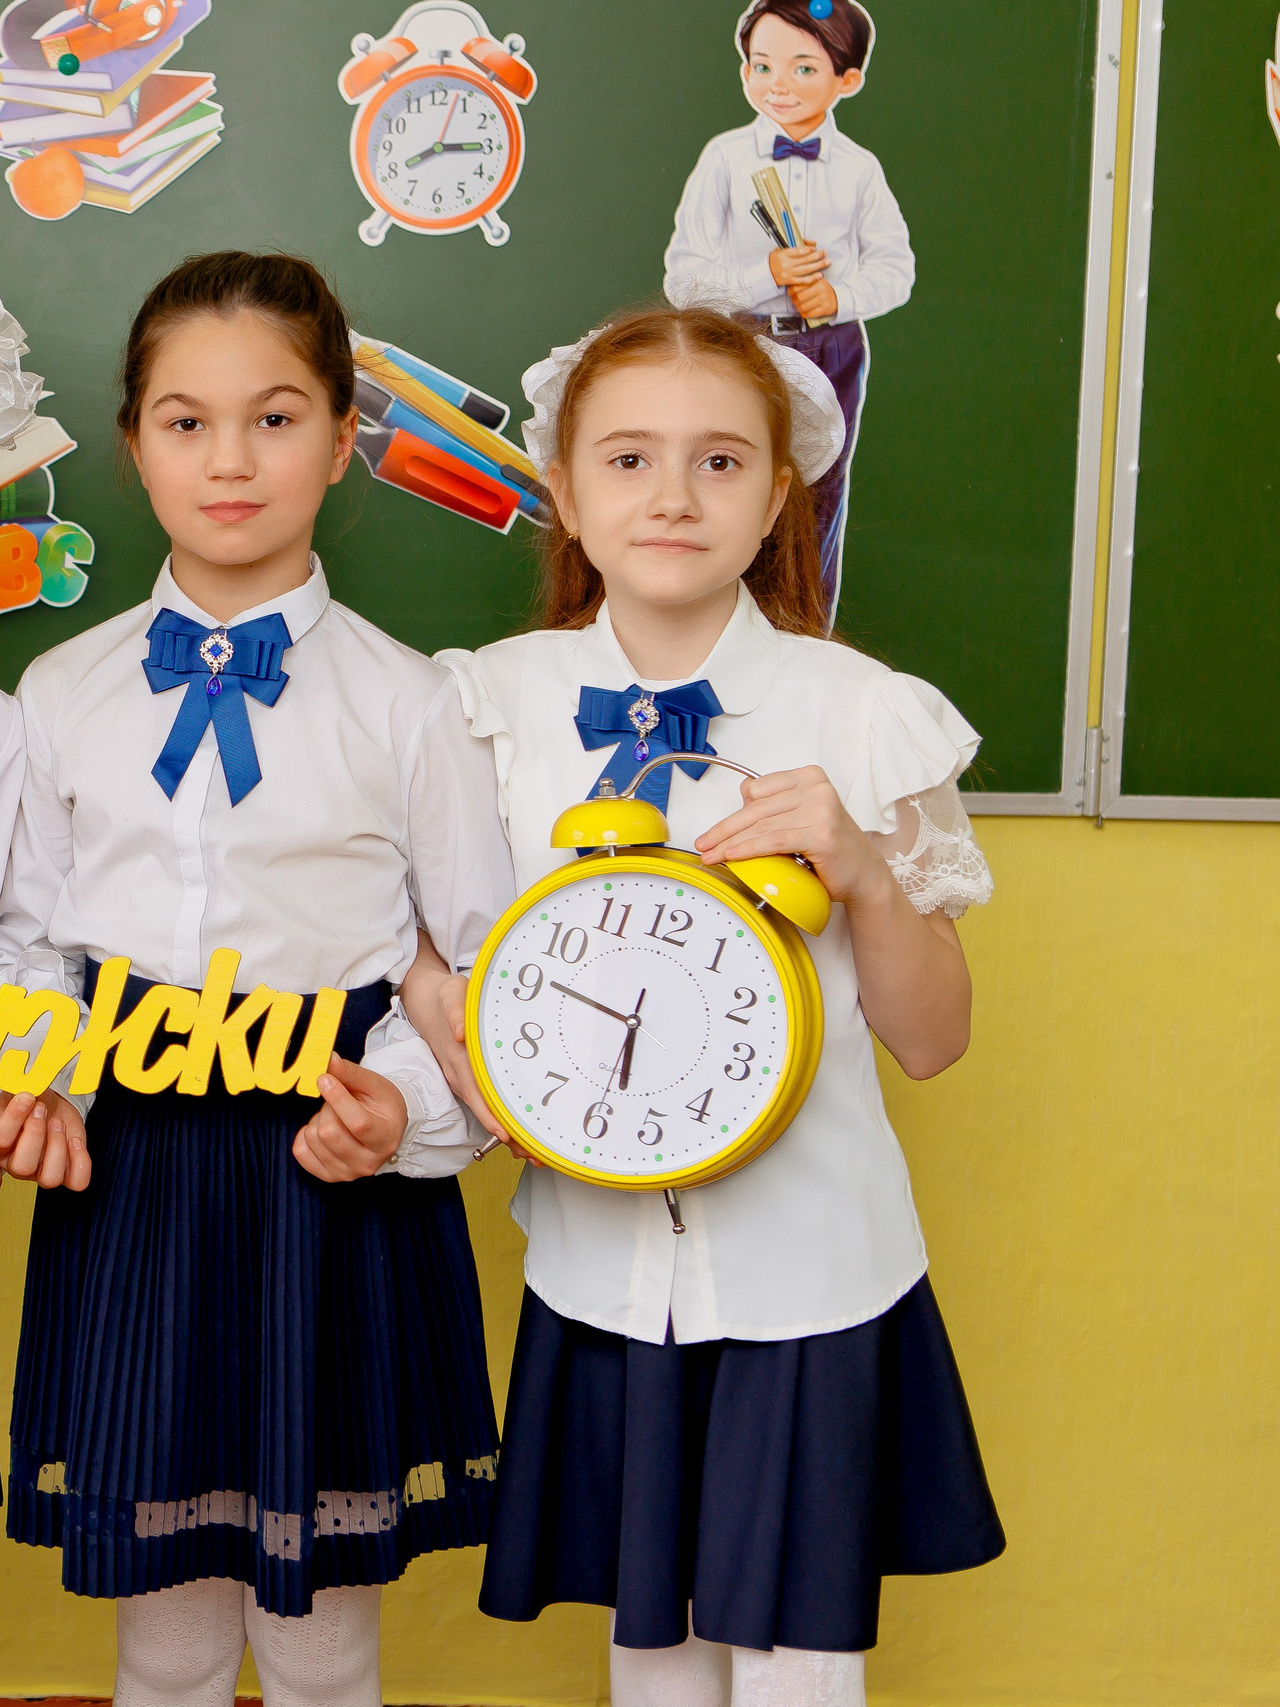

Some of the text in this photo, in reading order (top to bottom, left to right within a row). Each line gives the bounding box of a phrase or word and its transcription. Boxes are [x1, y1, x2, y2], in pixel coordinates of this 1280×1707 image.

[405, 97, 423, 114] 11
[429, 88, 449, 106] 12
[460, 97, 469, 114] 1
[386, 117, 407, 135] 10
[477, 112, 488, 130] 2
[382, 140, 393, 157] 9
[482, 138, 494, 155] 3
[387, 161, 399, 179] 8
[473, 163, 485, 179] 4
[407, 179, 418, 197] 7
[432, 187, 443, 205] 6
[455, 181, 467, 198] 5
[592, 897, 633, 940] 11
[644, 903, 695, 948] 12
[540, 921, 589, 964] 10
[705, 937, 728, 974] 1
[512, 963, 544, 1001] 9
[724, 986, 758, 1026] 2
[512, 1021, 544, 1060] 8
[723, 1042, 757, 1082] 3
[541, 1070, 570, 1107] 7
[685, 1087, 714, 1125] 4
[582, 1101, 614, 1140] 6
[637, 1107, 669, 1146] 5
